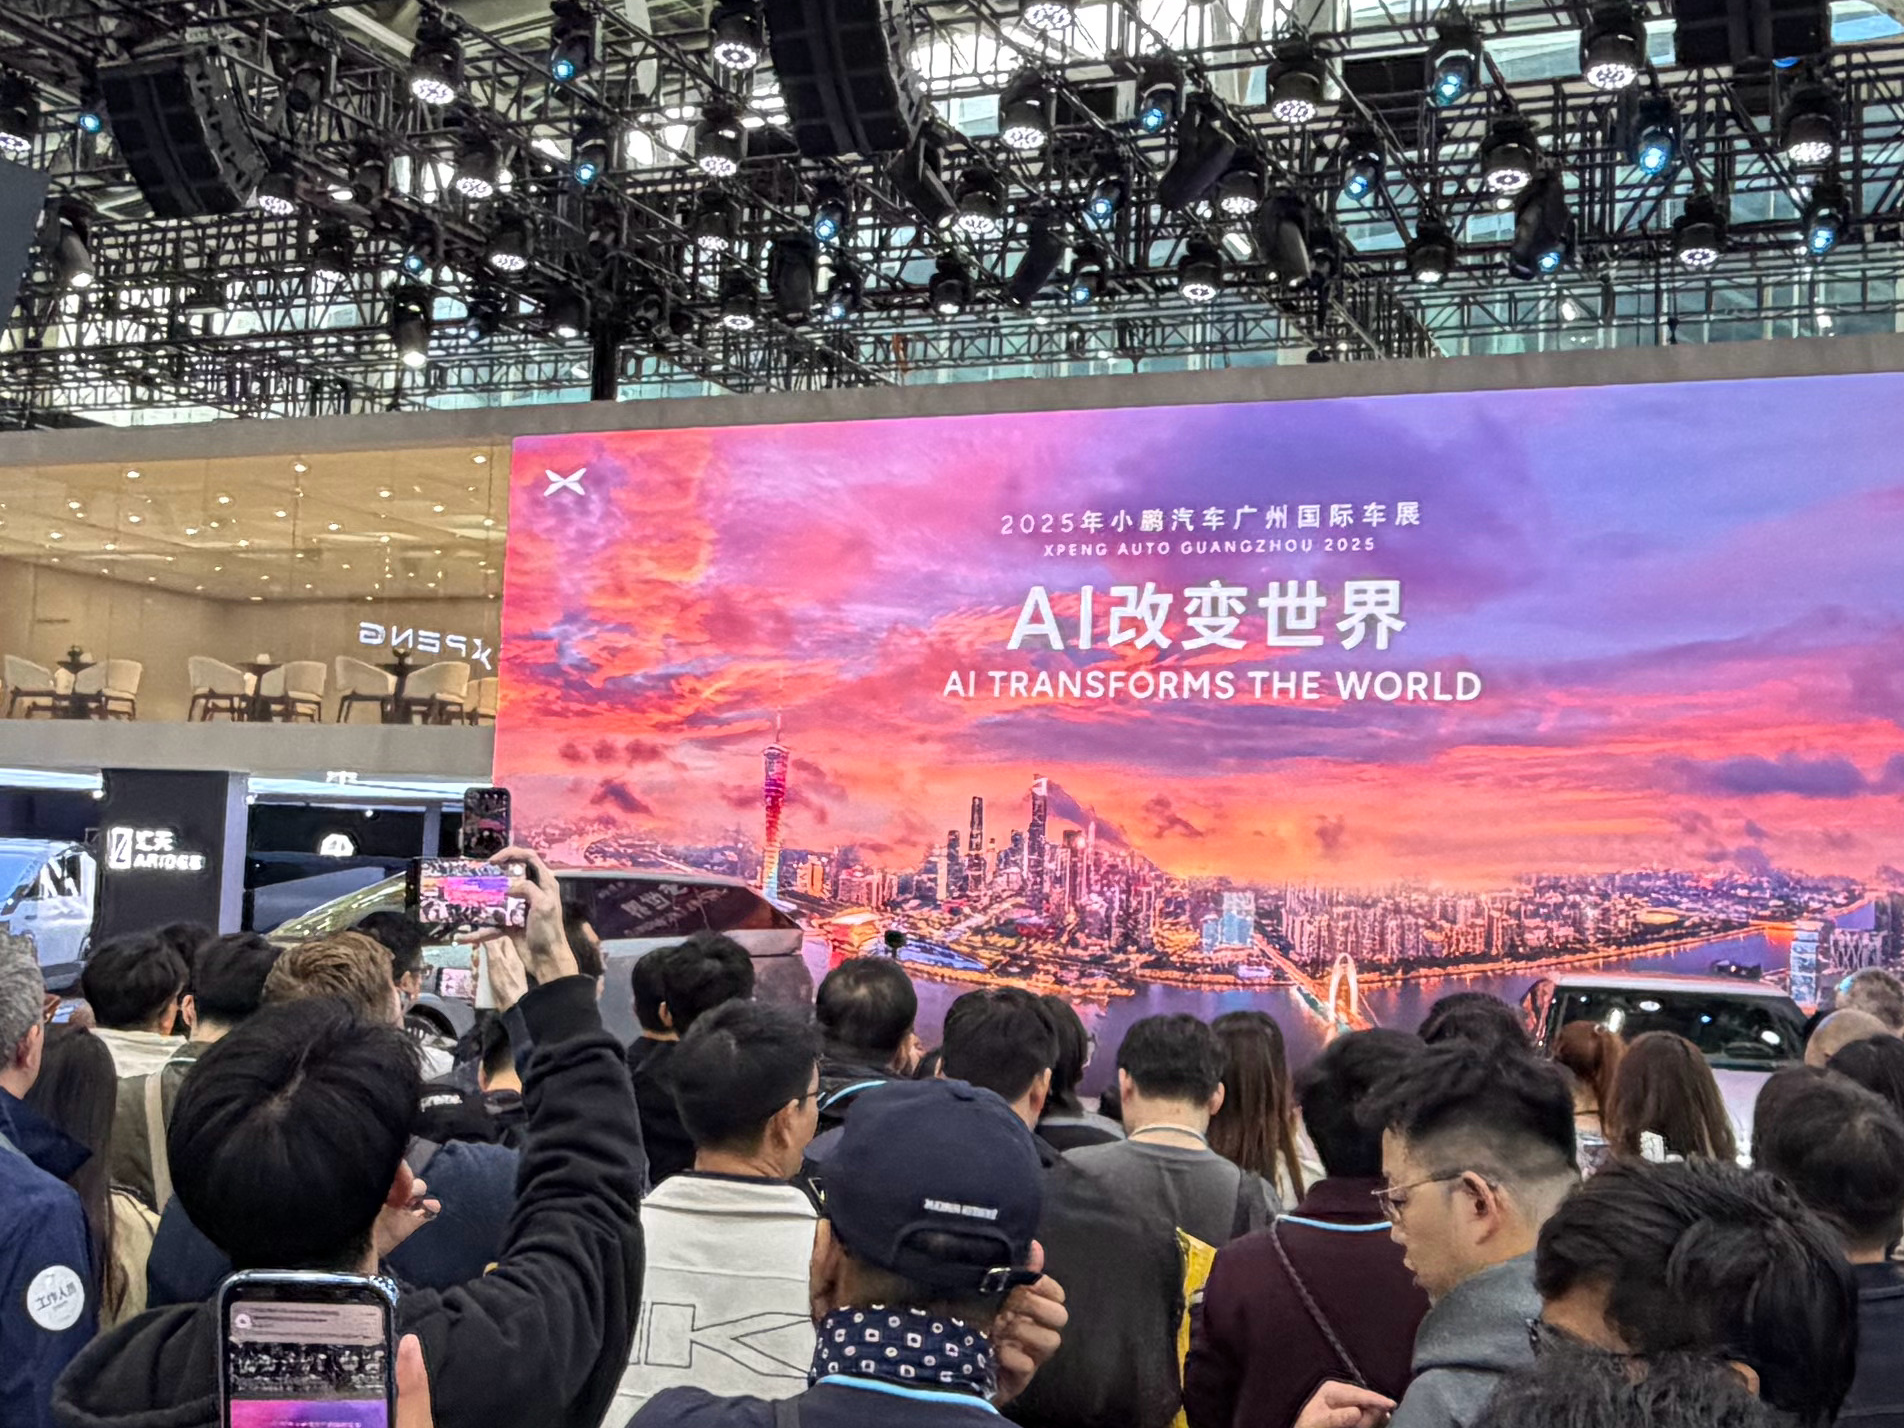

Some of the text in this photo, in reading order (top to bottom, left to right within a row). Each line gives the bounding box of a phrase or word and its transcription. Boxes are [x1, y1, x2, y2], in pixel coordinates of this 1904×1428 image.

[1000, 501, 1421, 535] 2025年小鹏汽车广州国际车展
[1043, 536, 1376, 557] XPENG AUTO GUANGZHOU 2025
[1005, 580, 1407, 651] AI改变世界
[942, 669, 1483, 702] AI TRANSFORMS THE WORLD
